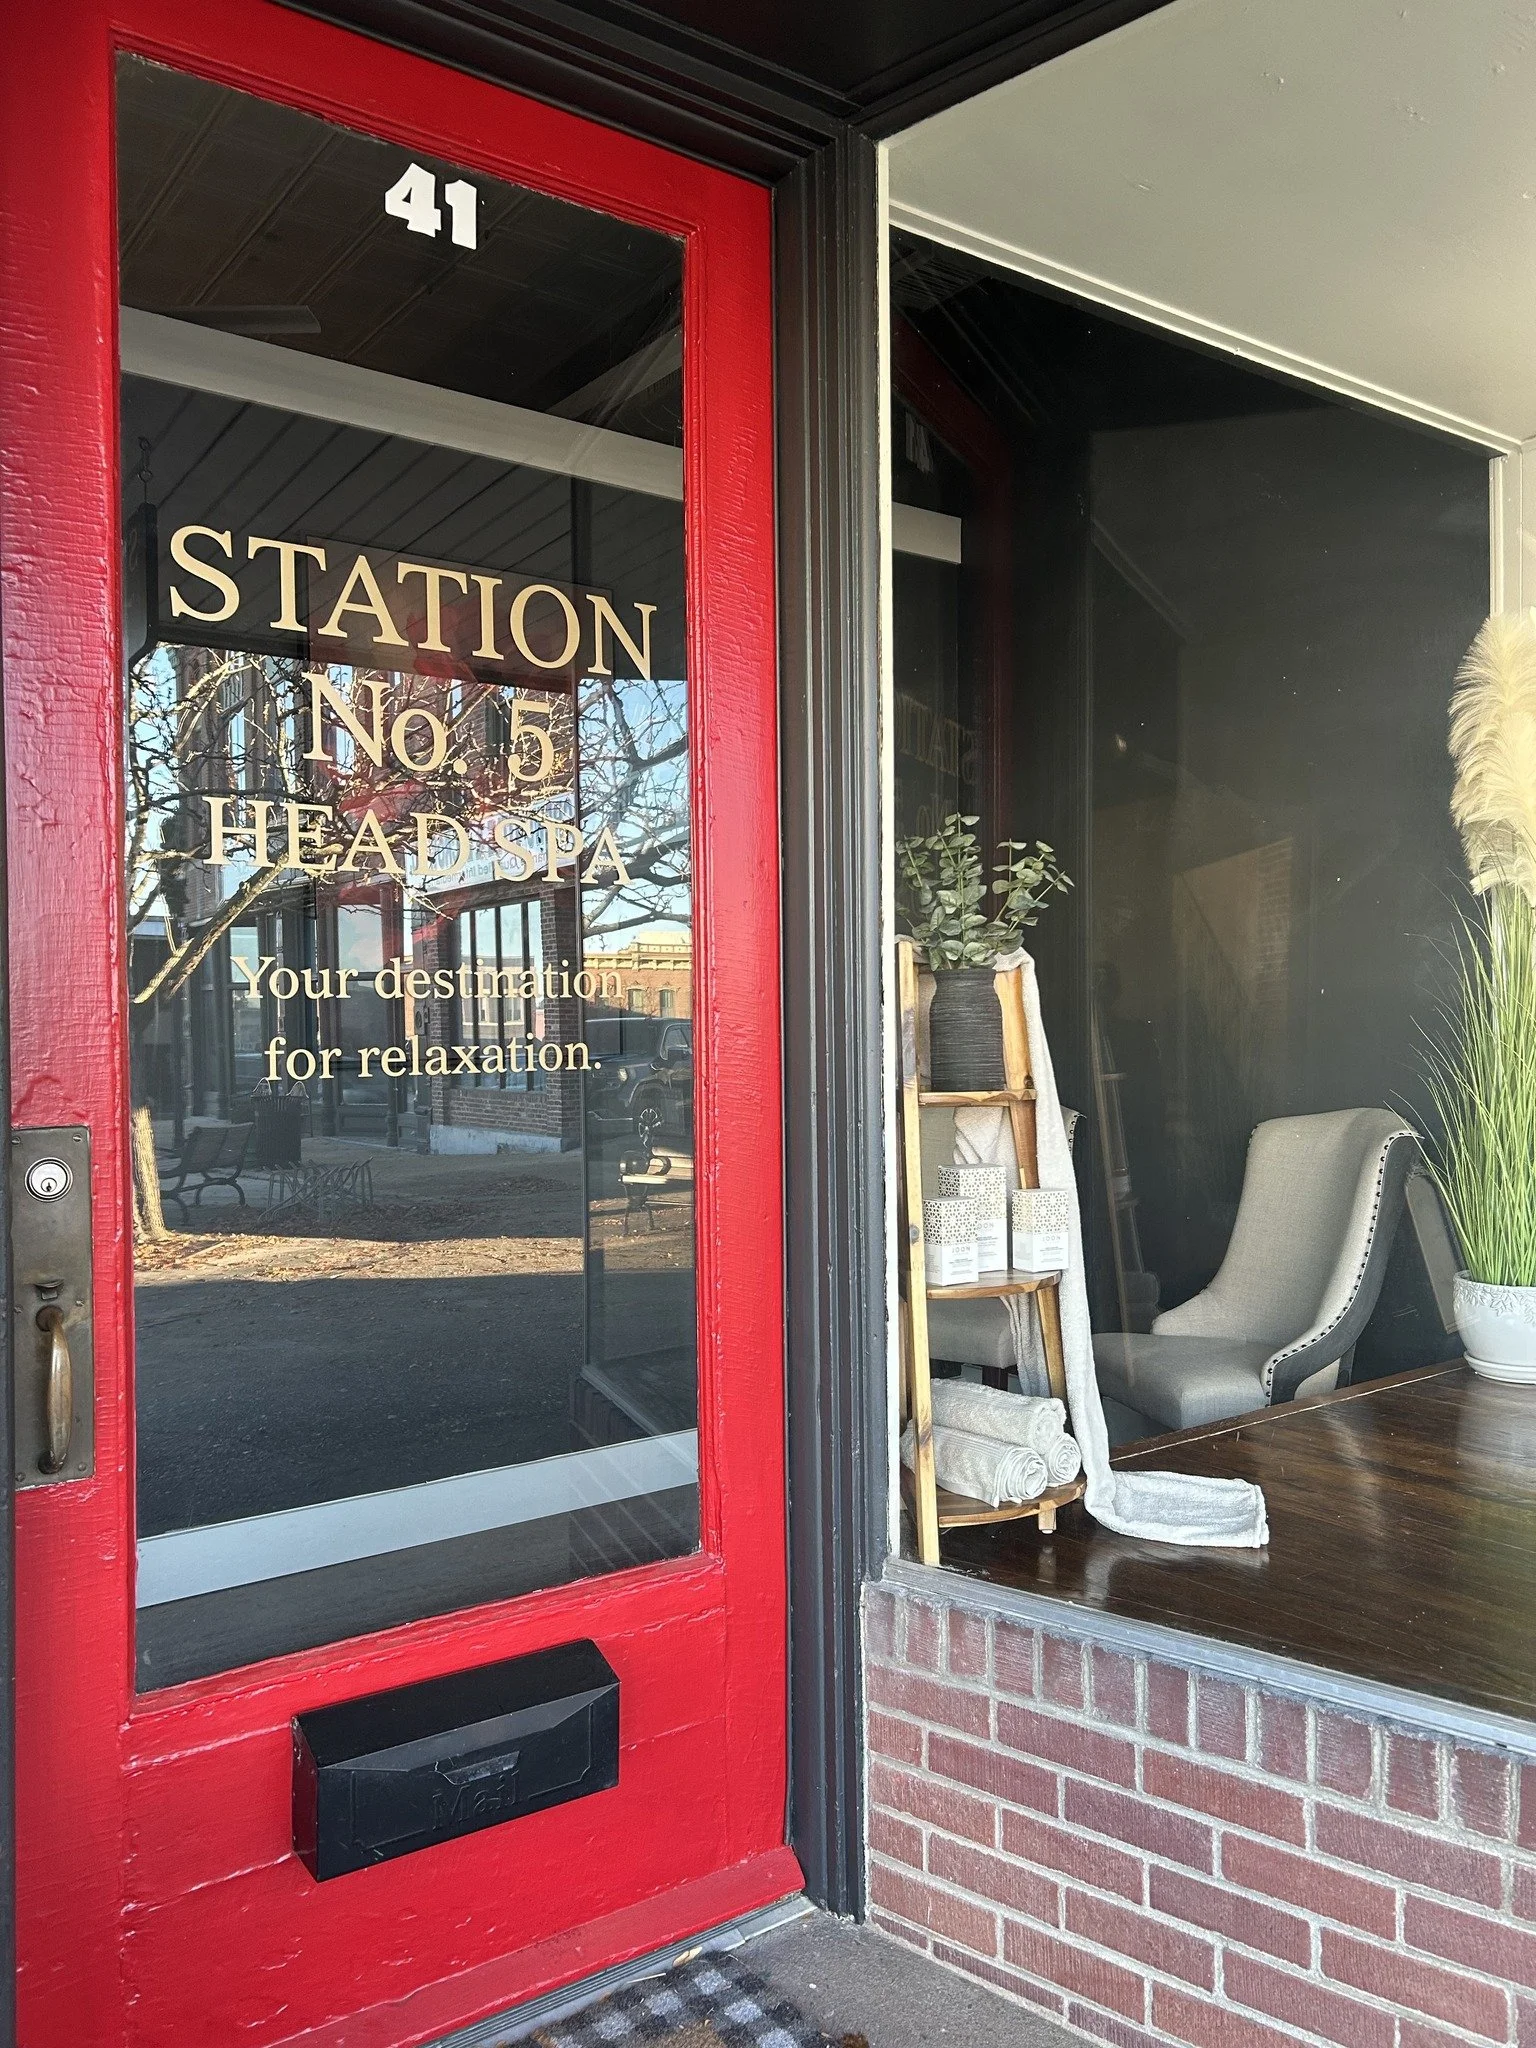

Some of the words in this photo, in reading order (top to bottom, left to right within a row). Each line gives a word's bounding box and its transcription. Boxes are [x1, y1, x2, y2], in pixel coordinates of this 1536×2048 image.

[385, 162, 477, 250] 41
[169, 525, 657, 680] STATION
[302, 671, 468, 775] No.
[508, 697, 555, 783] 5
[202, 796, 471, 877] HEAD
[494, 816, 634, 885] SPA
[231, 954, 358, 1000] Your
[373, 956, 625, 999] destination
[264, 1038, 342, 1082] for
[358, 1036, 602, 1079] relaxation.
[976, 1222, 994, 1230] OON
